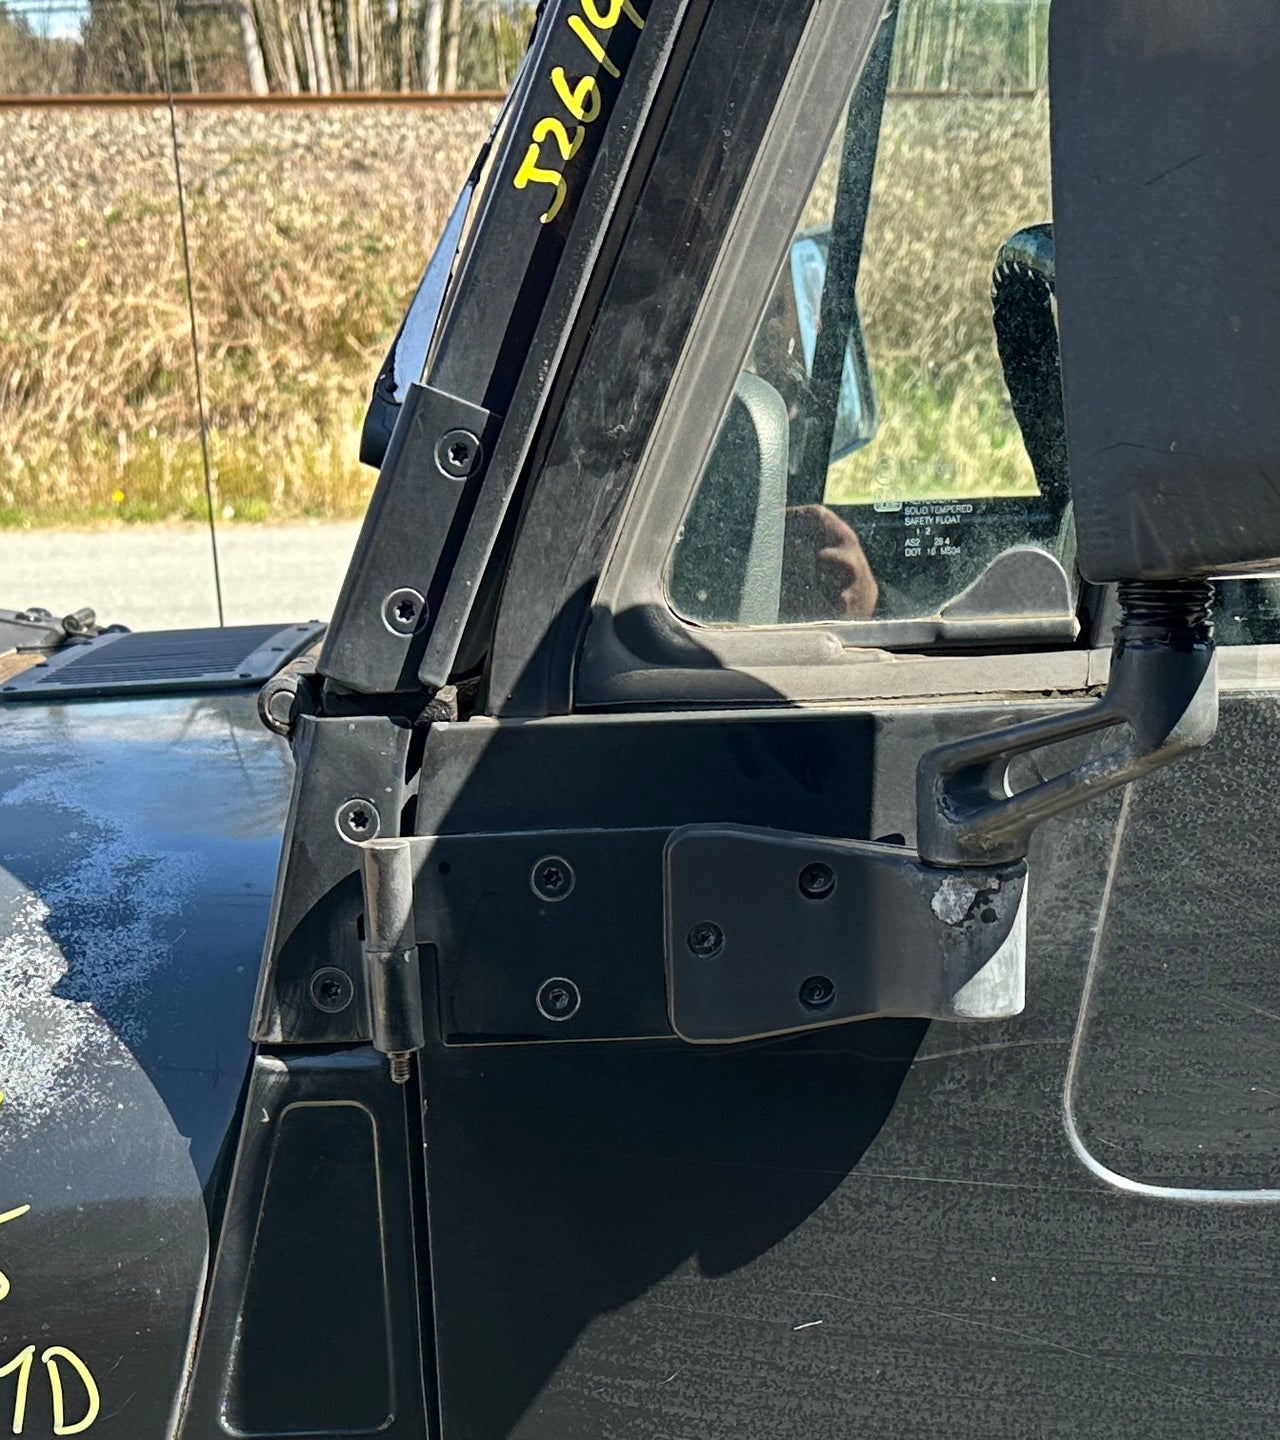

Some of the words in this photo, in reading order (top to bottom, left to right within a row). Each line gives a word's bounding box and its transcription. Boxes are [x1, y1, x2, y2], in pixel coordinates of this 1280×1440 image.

[904, 506, 929, 516] SOLID
[930, 504, 973, 514] TEMPERED
[904, 516, 934, 526] SAFETY
[935, 515, 961, 524] FLOAT
[904, 547, 921, 557] DOT
